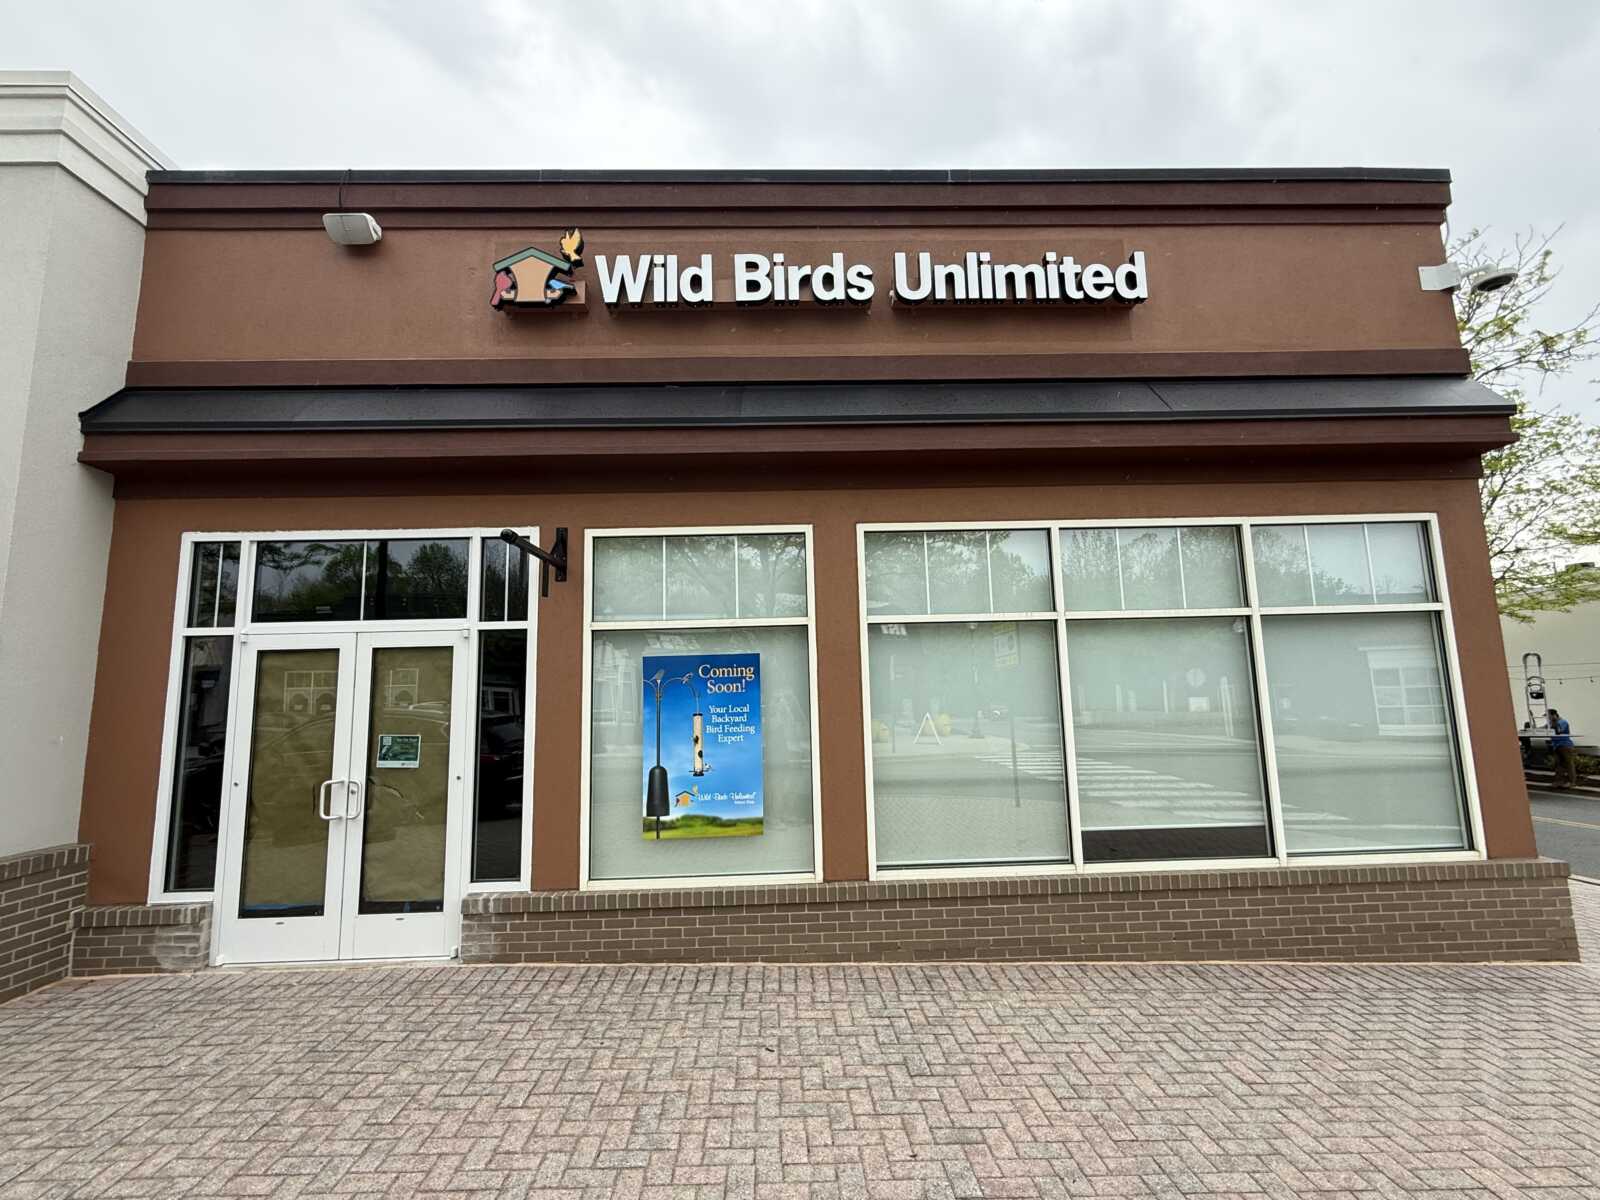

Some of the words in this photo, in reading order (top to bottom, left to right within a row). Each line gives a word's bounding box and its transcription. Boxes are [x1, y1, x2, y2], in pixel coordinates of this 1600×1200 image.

[594, 253, 713, 304] Wild
[733, 251, 876, 303] Birds
[894, 249, 1149, 302] Unlimited
[698, 664, 755, 681] Coming
[706, 679, 746, 694] Soon!
[709, 705, 728, 714] Your
[728, 703, 750, 713] Local
[711, 714, 747, 724] Backyard
[706, 725, 723, 734] Bird
[724, 724, 756, 735] Feeding
[718, 734, 744, 744] Expert
